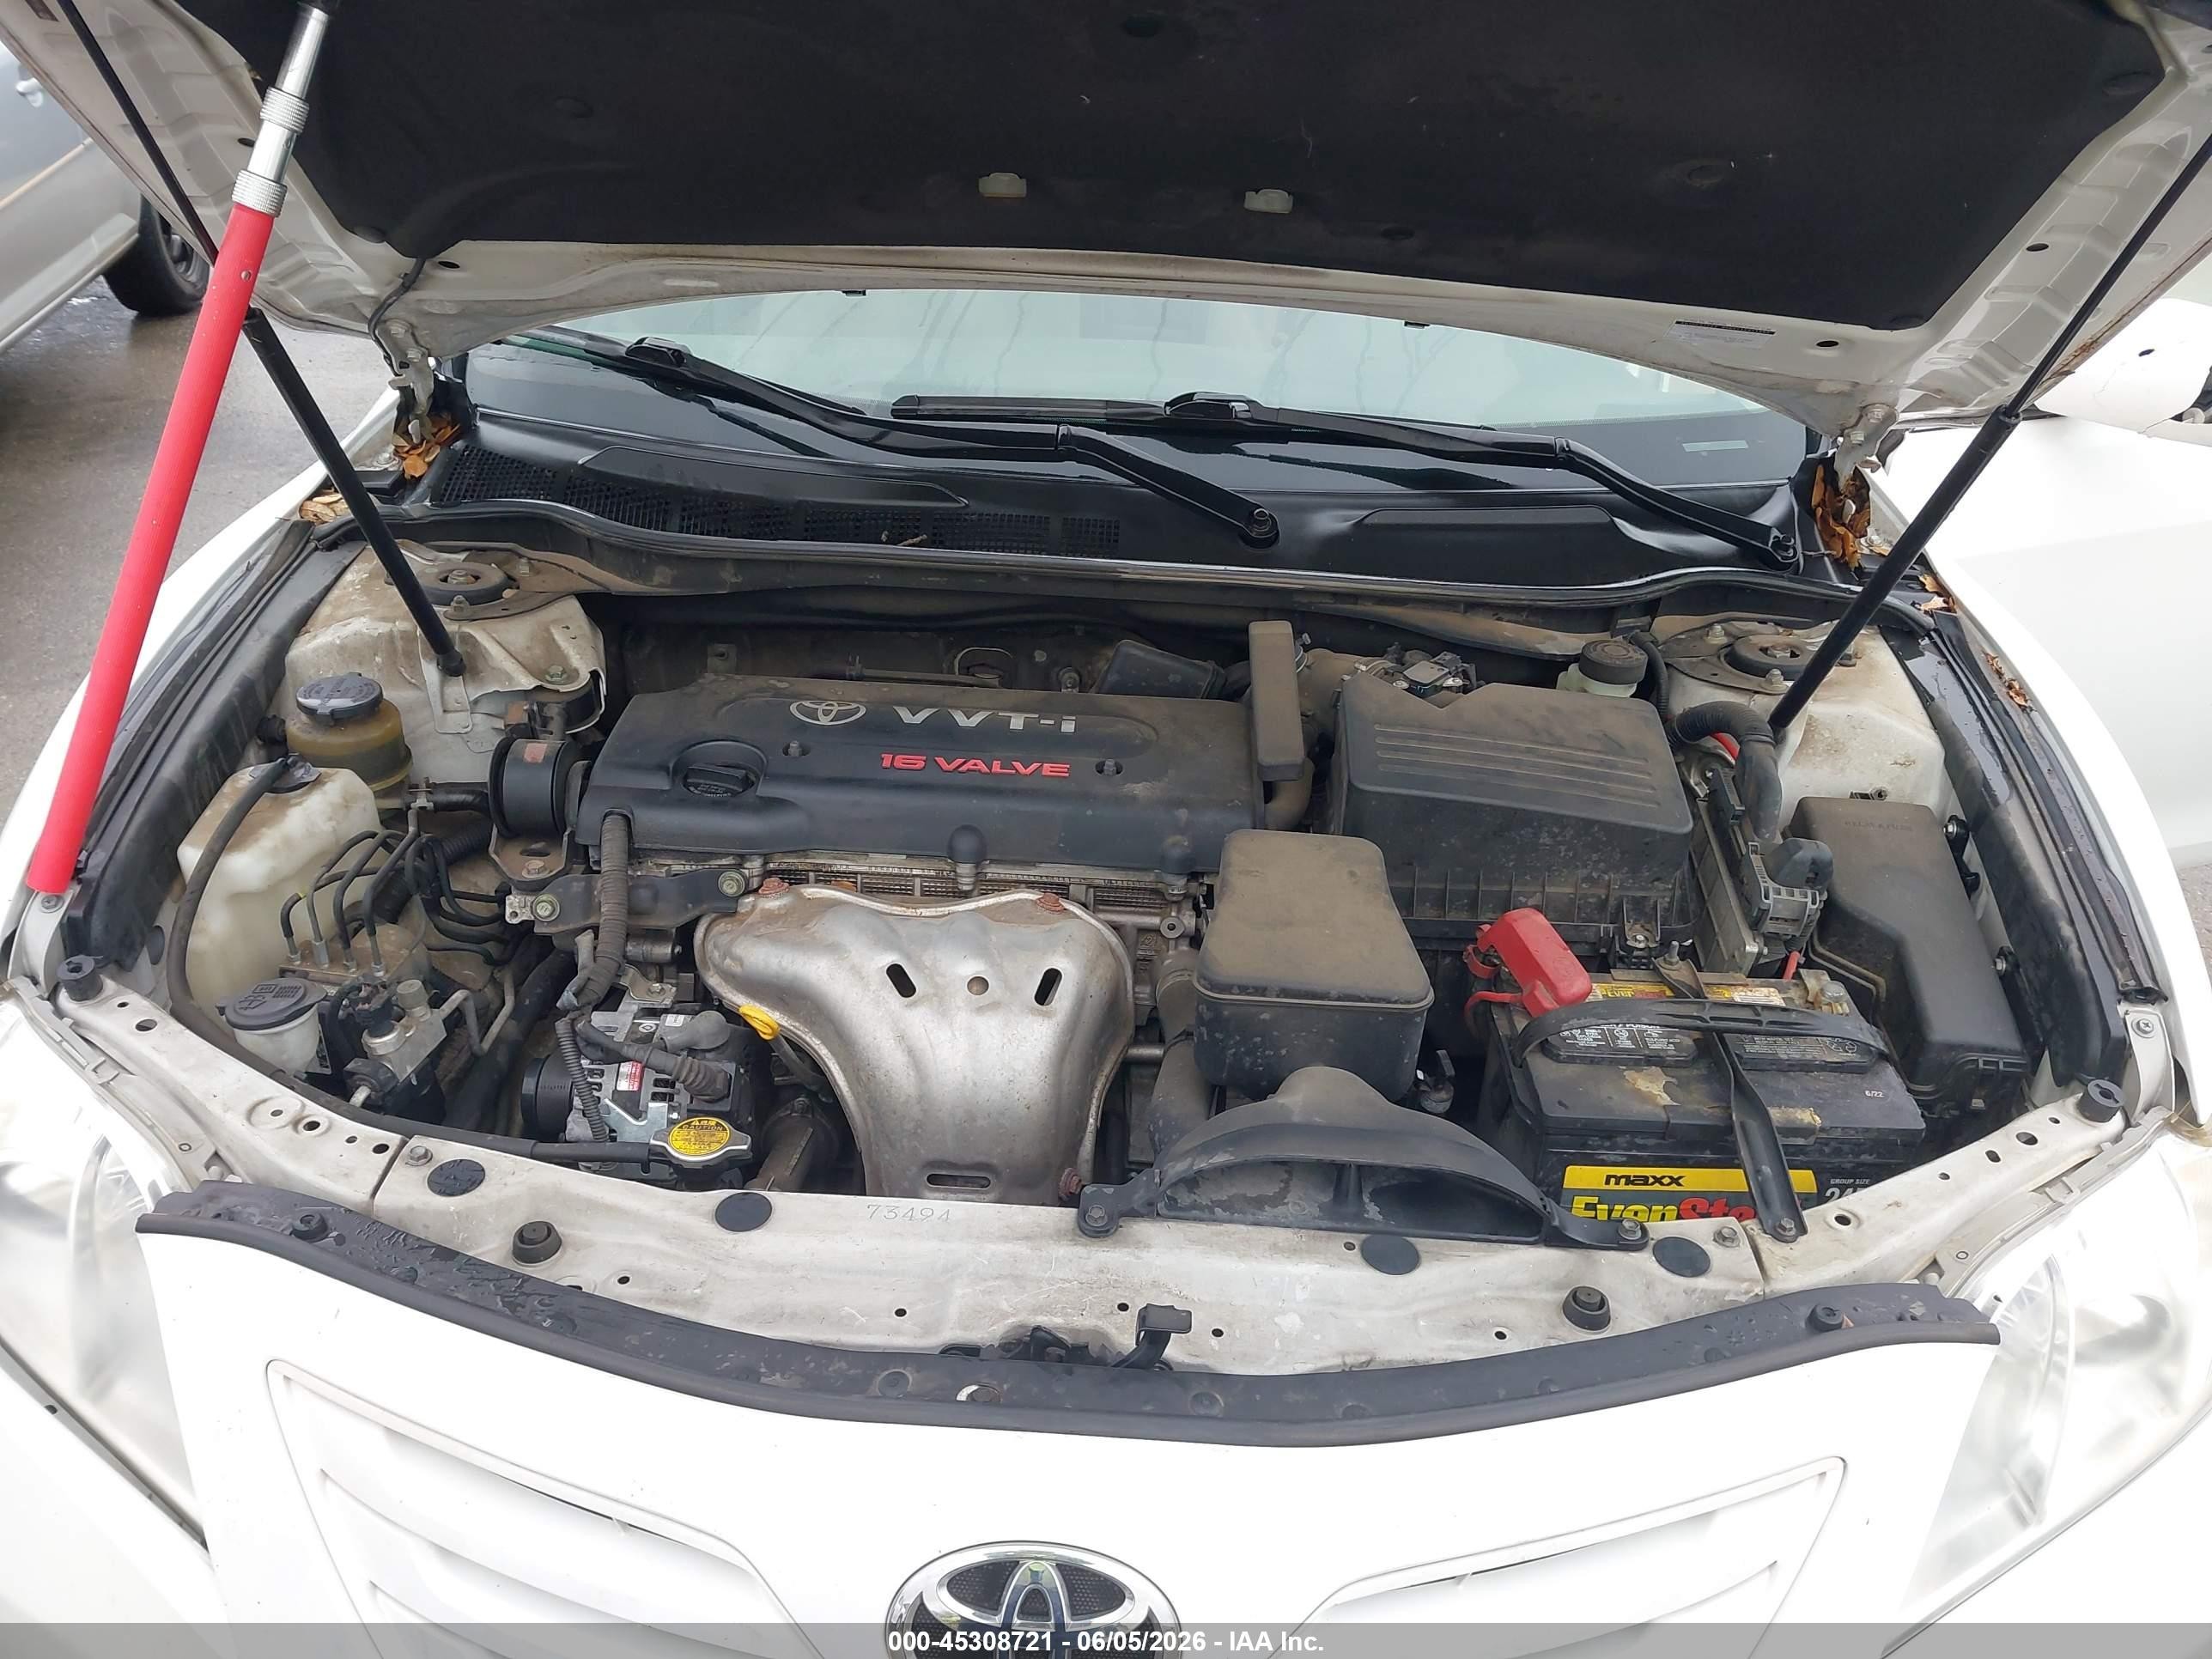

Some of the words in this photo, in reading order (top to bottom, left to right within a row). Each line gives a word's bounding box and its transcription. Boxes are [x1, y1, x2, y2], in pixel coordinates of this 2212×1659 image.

[892, 705, 1077, 733] VVT-i
[881, 753, 927, 770] 16
[934, 757, 1070, 777] VALVE
